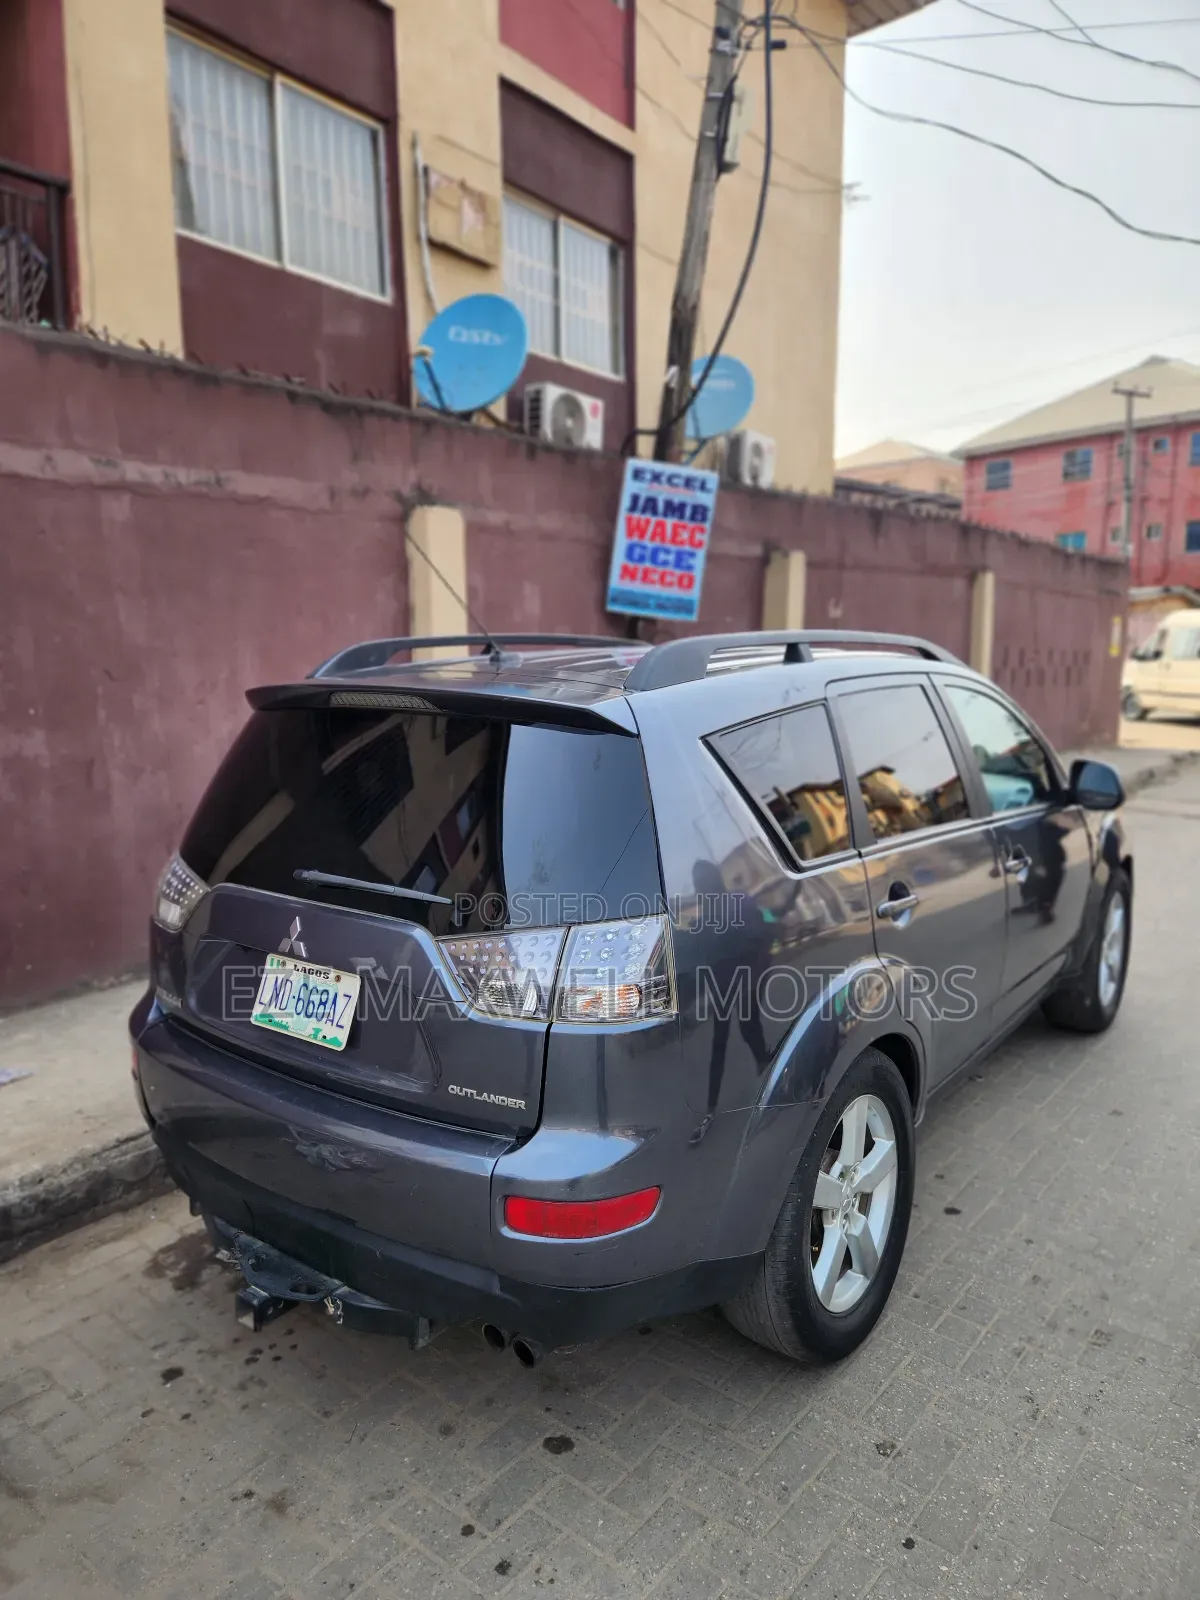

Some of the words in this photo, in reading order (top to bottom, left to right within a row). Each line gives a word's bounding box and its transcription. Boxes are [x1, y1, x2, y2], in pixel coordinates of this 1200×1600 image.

[631, 467, 713, 493] EXCEL
[627, 493, 709, 523] JAMB
[625, 514, 707, 549] WAEC
[625, 542, 696, 571] GCE
[620, 563, 695, 591] NECO
[293, 963, 330, 980] LAGOS
[448, 1084, 526, 1110] OUTLANDER
